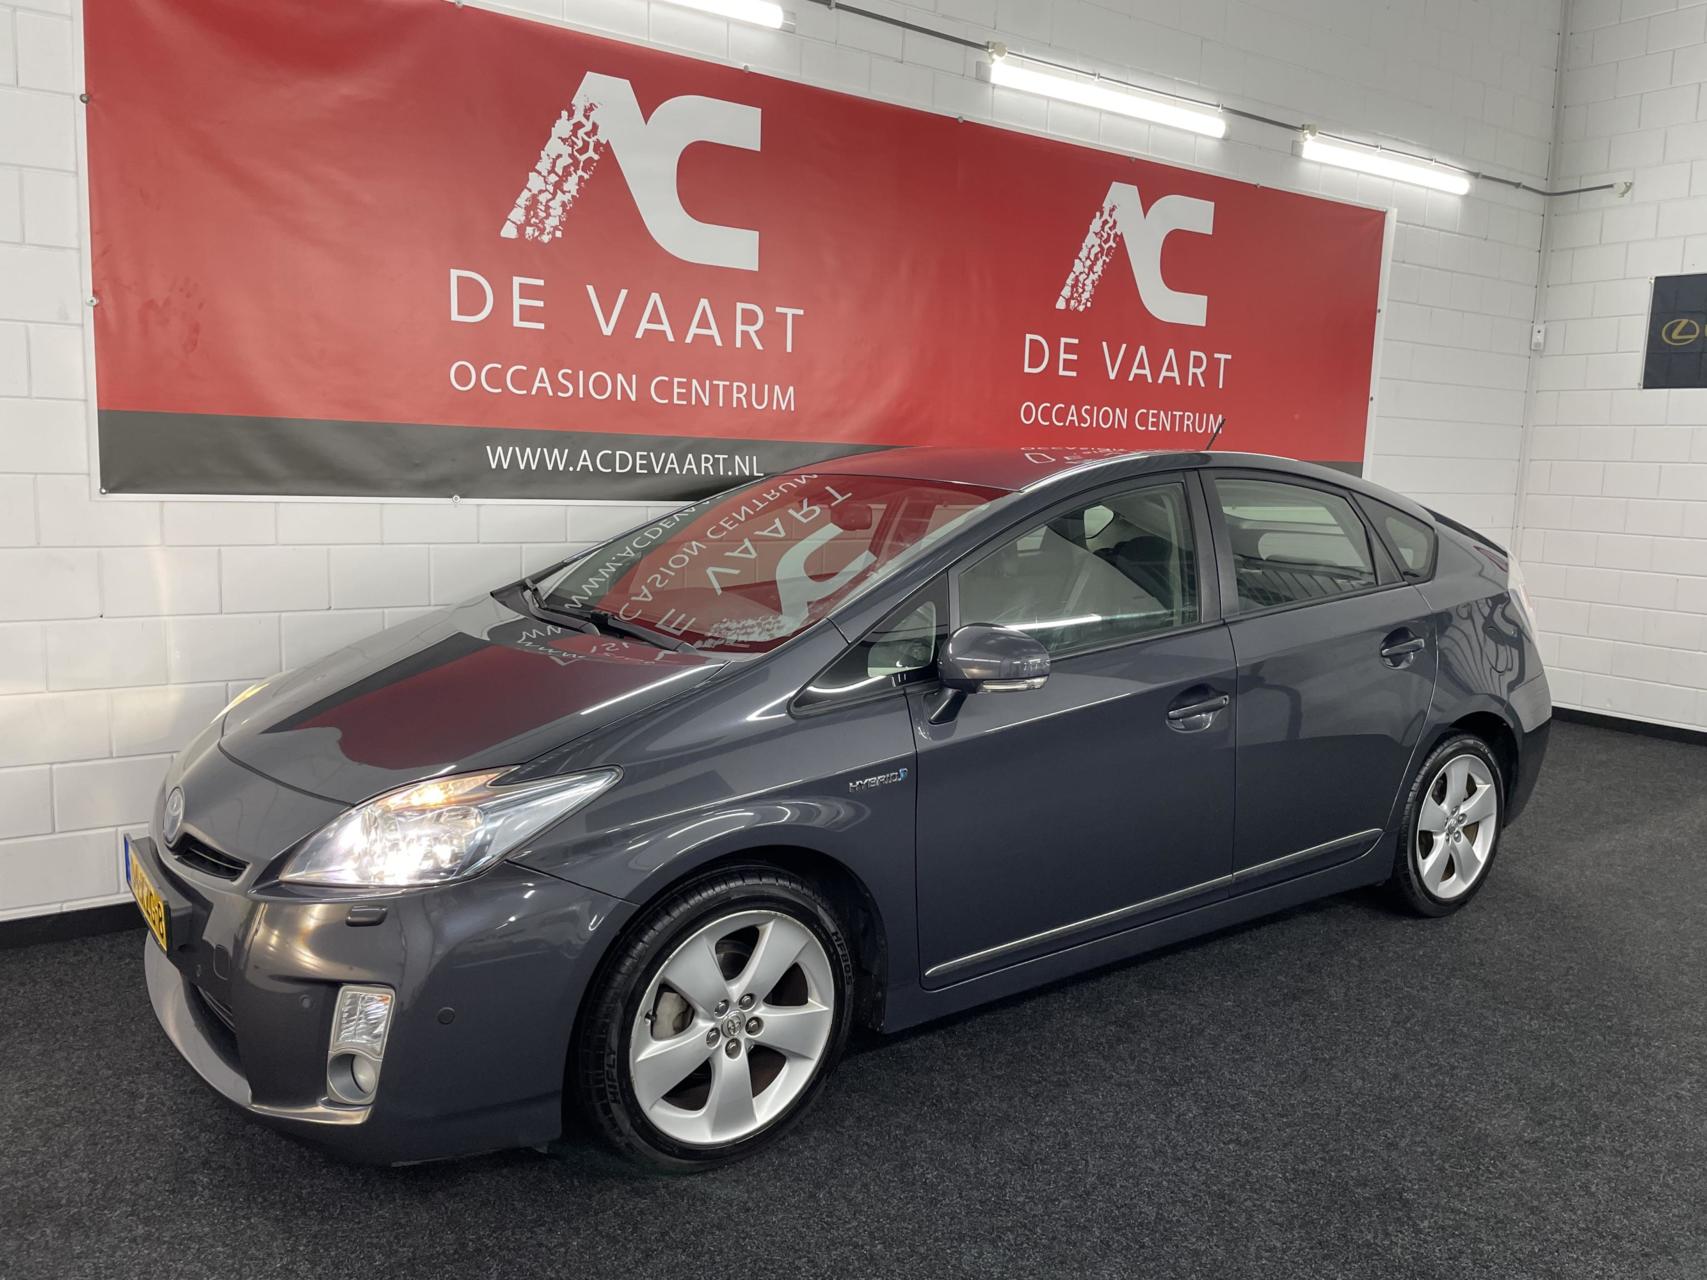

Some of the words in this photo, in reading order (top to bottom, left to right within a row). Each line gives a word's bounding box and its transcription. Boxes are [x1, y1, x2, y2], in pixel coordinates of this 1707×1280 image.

[500, 71, 762, 272] AC
[1055, 181, 1215, 327] AC
[449, 268, 545, 330] DE
[586, 284, 805, 353] VAART
[449, 360, 637, 402] OCCASION
[650, 375, 796, 412] CENTRUM
[1023, 333, 1080, 377] DE
[1102, 341, 1232, 389] VAART
[1020, 401, 1128, 430] OCCASION
[1134, 408, 1223, 434] CENTRUM
[486, 445, 765, 477] WWW.ACDEVAART.NL
[848, 772, 899, 793] HYBRID
